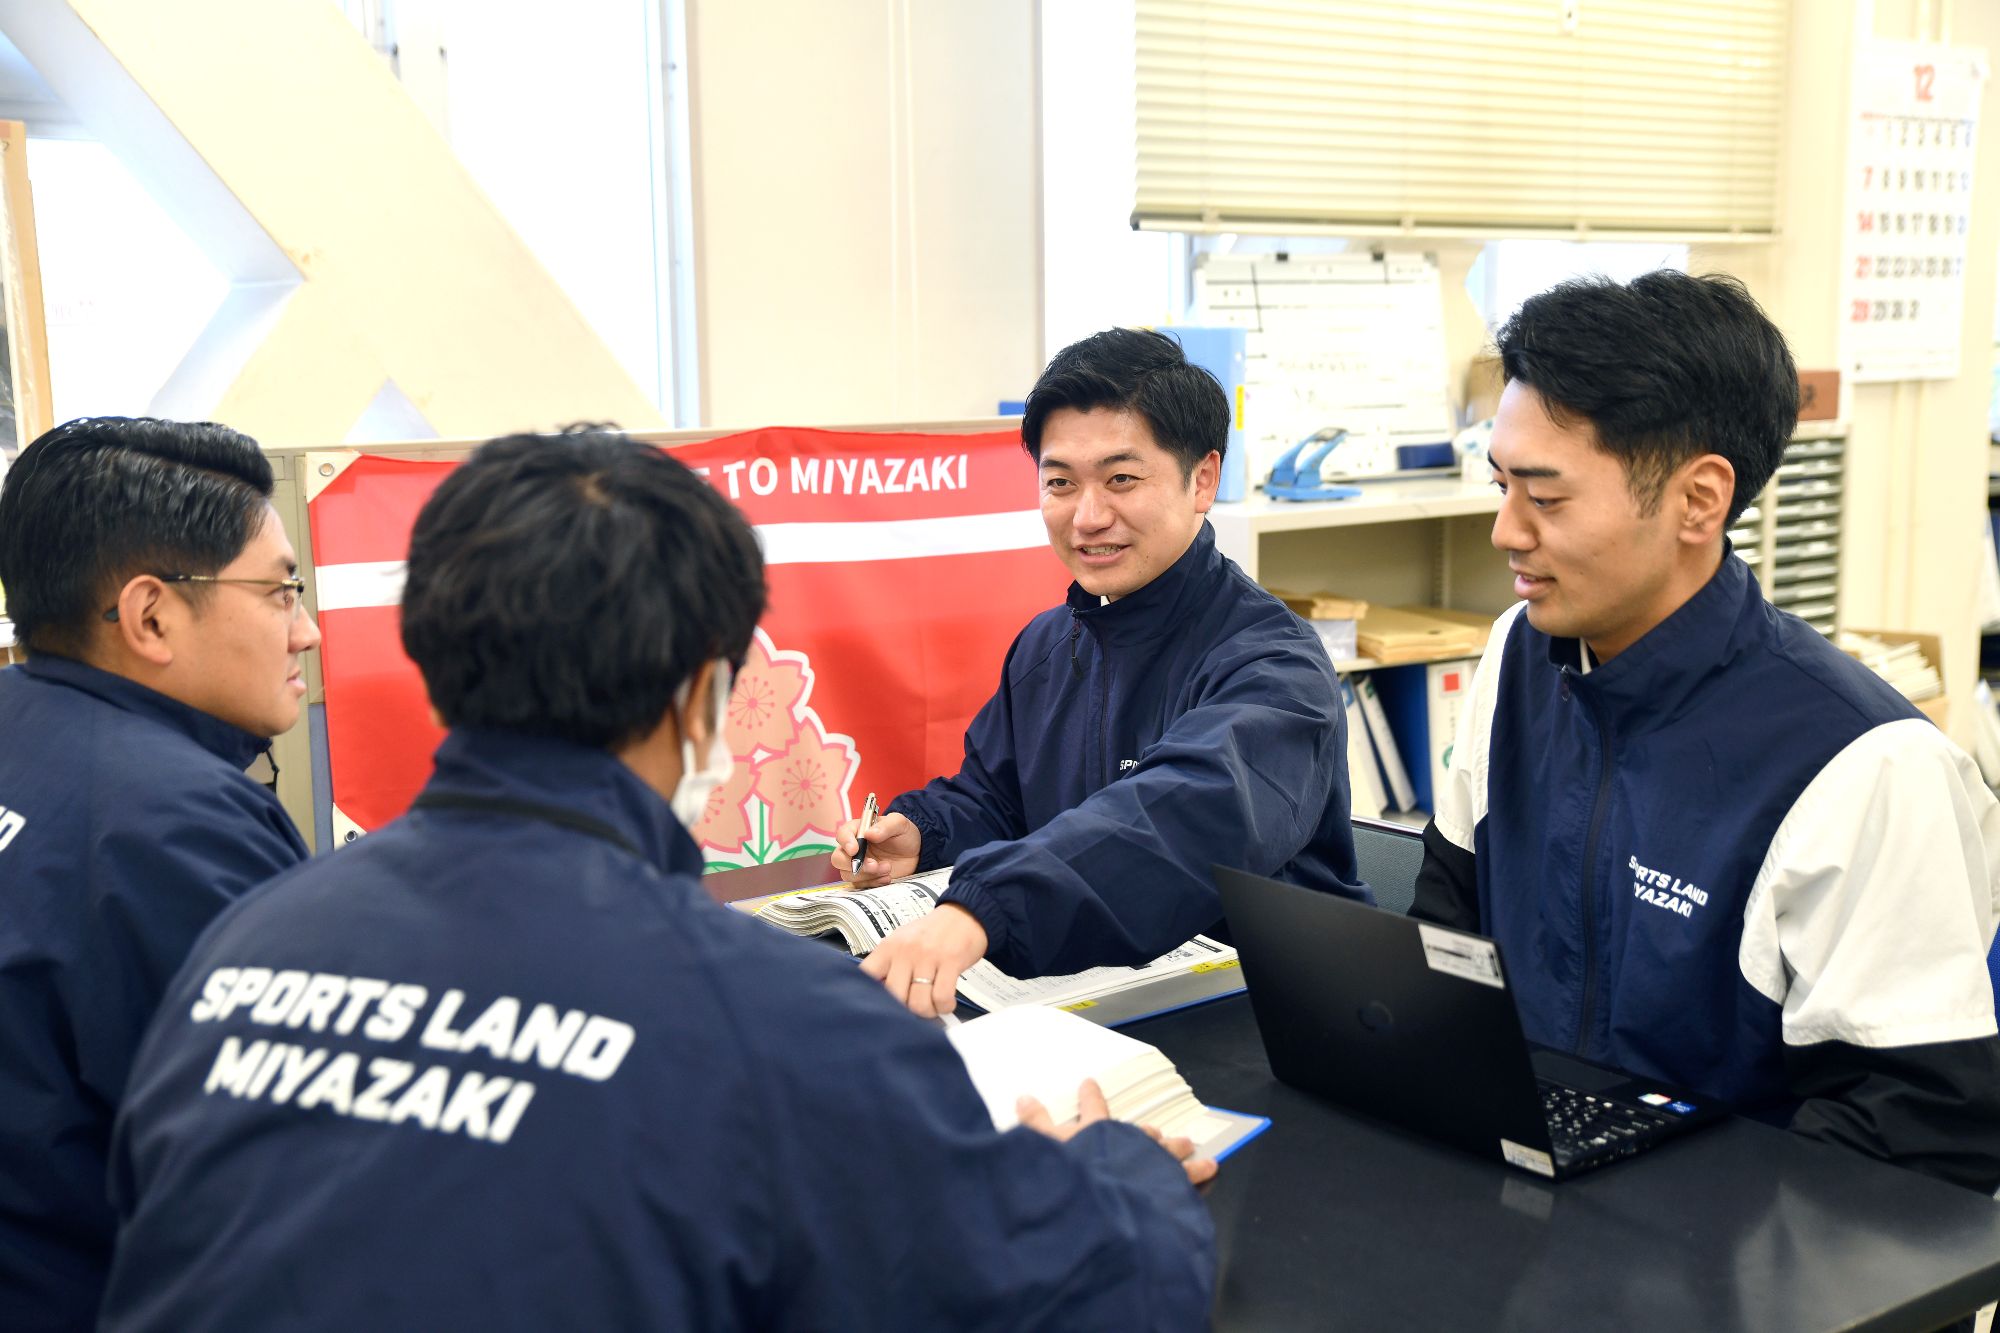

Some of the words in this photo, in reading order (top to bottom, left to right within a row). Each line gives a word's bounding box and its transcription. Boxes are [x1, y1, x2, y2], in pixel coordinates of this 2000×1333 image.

[1912, 63, 1935, 103] 12
[1862, 165, 1874, 191] 7
[722, 457, 779, 500] TO
[790, 454, 969, 496] MIYAZAKI
[1119, 759, 1139, 771] SPO
[1628, 855, 1672, 889] SRTS
[1670, 878, 1709, 907] LAND
[191, 966, 428, 1043] SPORTS
[420, 988, 636, 1083] LAND
[204, 1035, 537, 1145] MIYAZAKI
